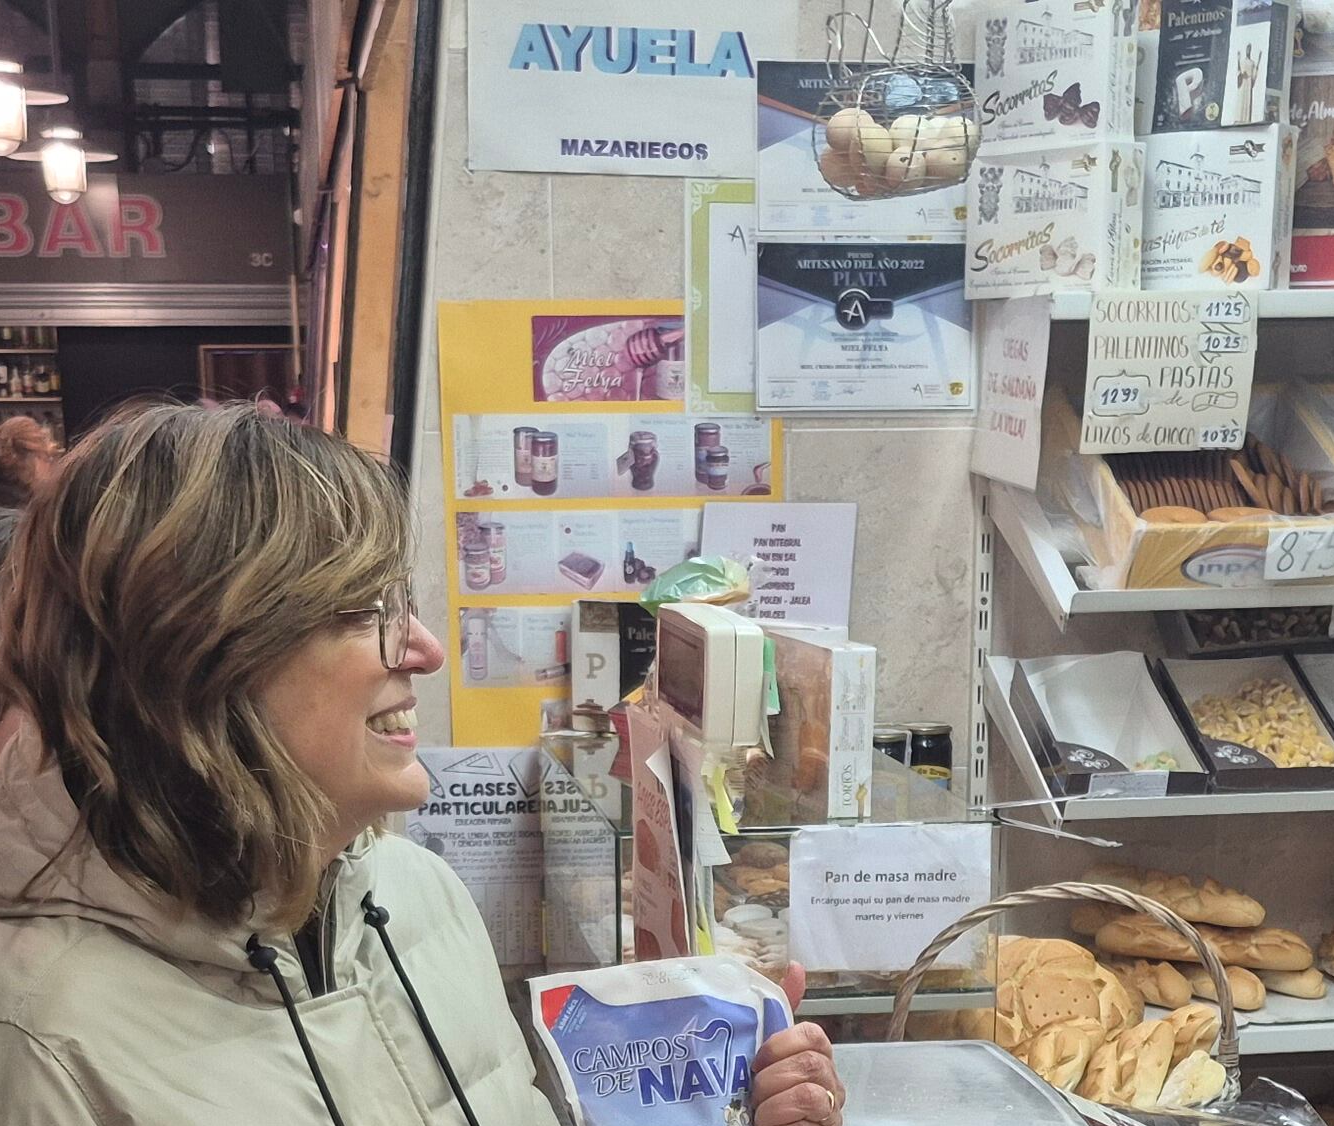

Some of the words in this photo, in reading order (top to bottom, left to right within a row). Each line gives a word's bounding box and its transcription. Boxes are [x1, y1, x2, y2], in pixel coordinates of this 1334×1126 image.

[1168, 8, 1225, 27] Palentinos
[509, 23, 755, 79] AYUELA
[560, 138, 709, 161] MAZARIEGOS
[796, 259, 854, 269] ARTESANO
[854, 260, 873, 269] DEL
[876, 257, 899, 269] AÑO
[900, 260, 925, 270] 2022
[833, 272, 888, 287] PLATA
[1093, 335, 1190, 360] PALENTINOS
[563, 347, 615, 372] Miel
[1159, 366, 1234, 389] PASTAS
[449, 782, 517, 797] CLASES
[825, 871, 849, 883] Pan
[853, 870, 871, 883] de
[875, 872, 909, 883] masa
[914, 869, 957, 882] madre
[811, 896, 850, 906] Encargue
[885, 897, 902, 905] pan
[903, 895, 915, 904] de
[917, 896, 940, 904] masa
[942, 895, 971, 904] madre
[855, 912, 885, 921] martes
[893, 911, 924, 921] viernes
[572, 1032, 689, 1074] CAMPOS
[593, 1069, 636, 1096] DE
[637, 1024, 752, 1106] NAVA
